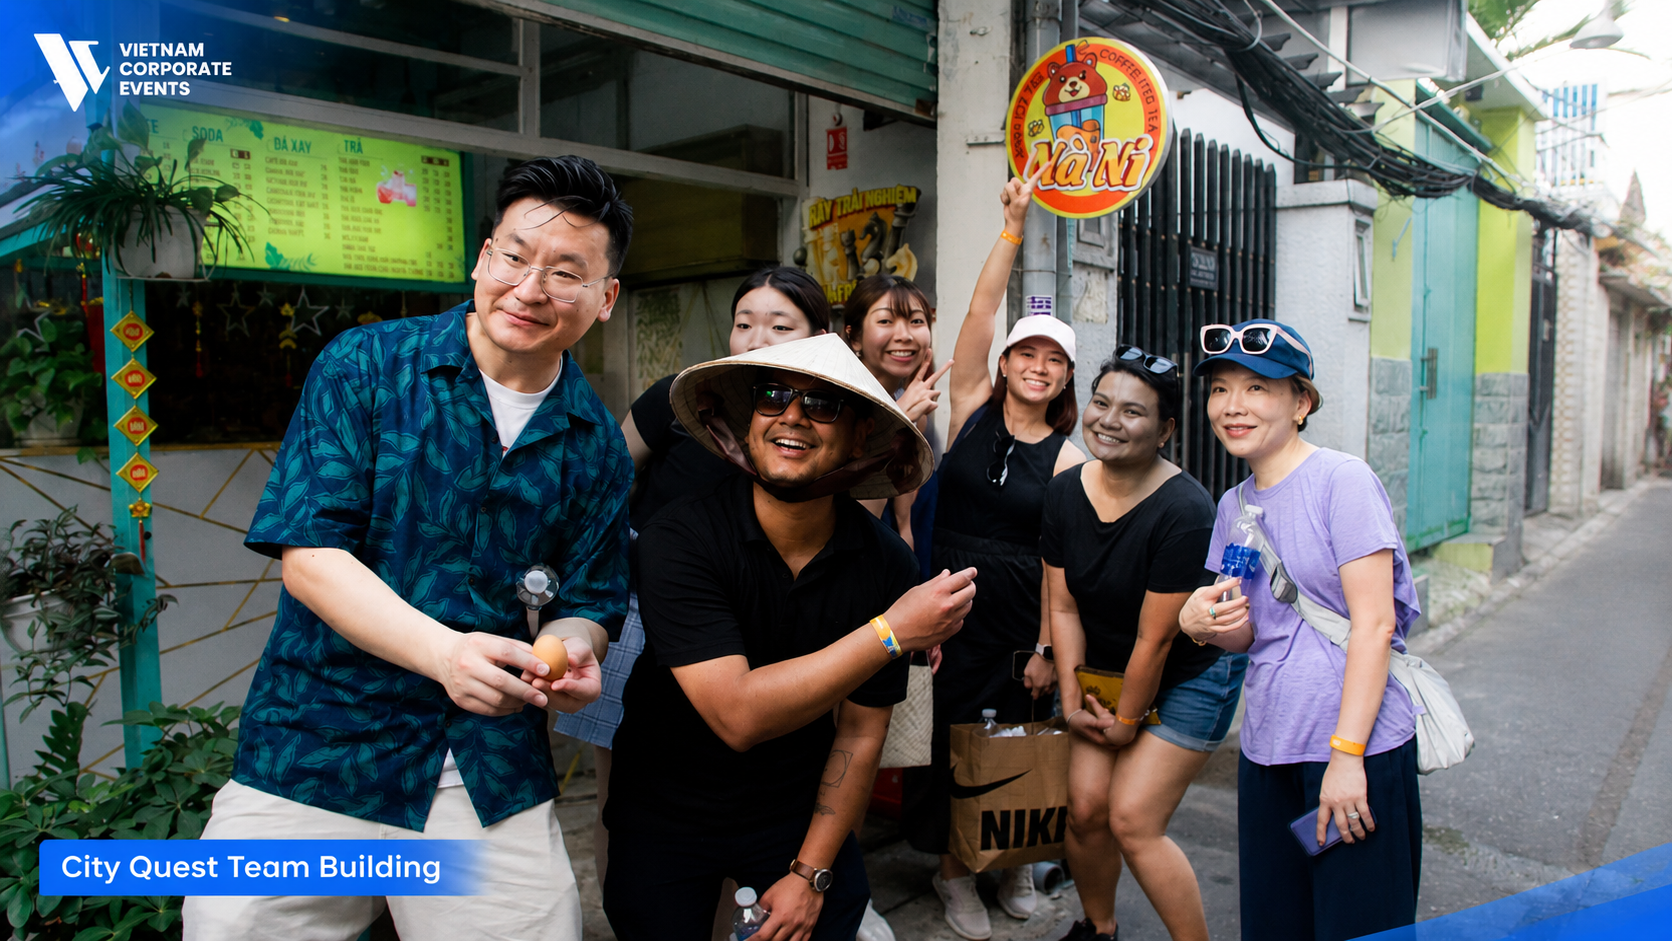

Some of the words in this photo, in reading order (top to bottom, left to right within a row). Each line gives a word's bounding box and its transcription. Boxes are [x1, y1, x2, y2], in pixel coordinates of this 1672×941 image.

[192, 125, 224, 143] SODA
[290, 138, 312, 154] XAY
[1092, 135, 1152, 191] Ni
